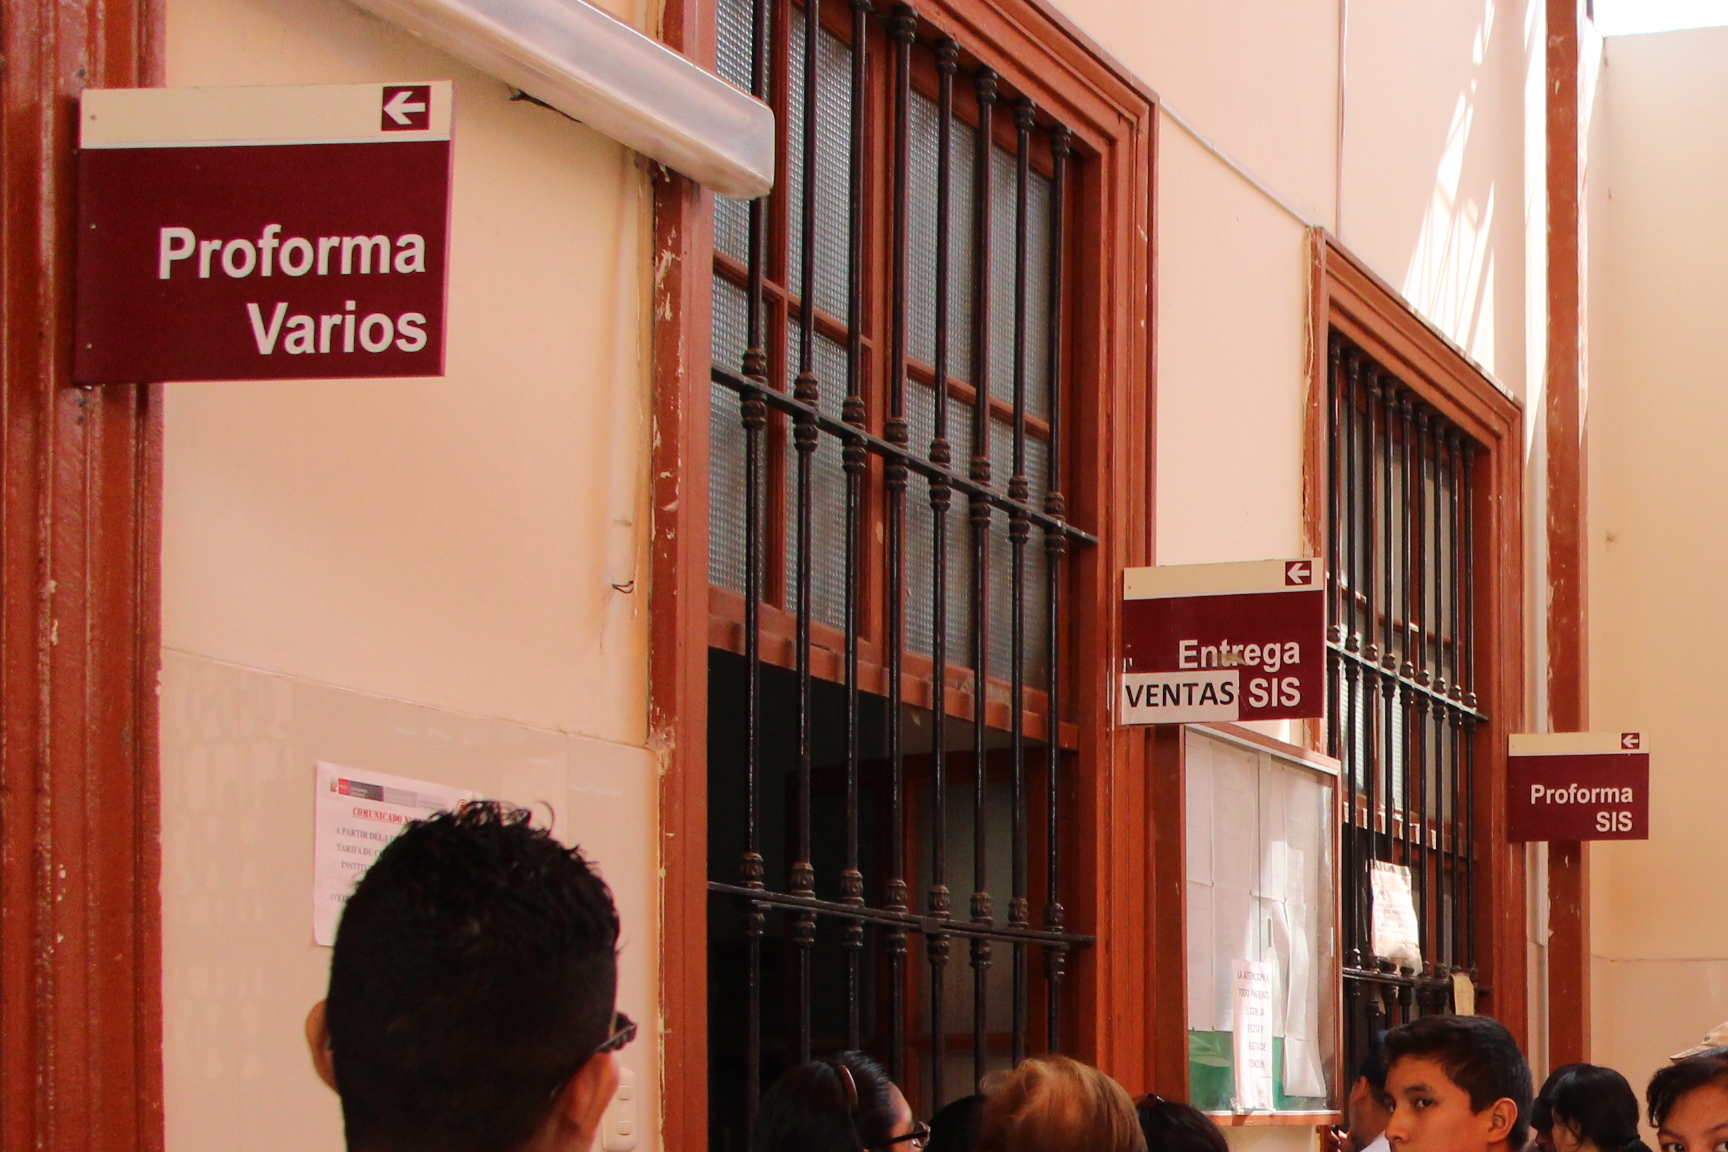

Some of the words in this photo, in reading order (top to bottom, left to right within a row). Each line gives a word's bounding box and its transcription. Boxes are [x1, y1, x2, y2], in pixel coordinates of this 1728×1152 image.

[159, 224, 426, 279] Proforma
[247, 300, 427, 355] Varios
[1179, 639, 1300, 673] Entrega
[1125, 681, 1235, 708] VENTAS
[1249, 677, 1301, 708] SIS
[1530, 783, 1633, 804] Proforma
[353, 808, 402, 824] COMUNICADO
[1595, 811, 1633, 832] SIS
[342, 828, 368, 839] PARTIR
